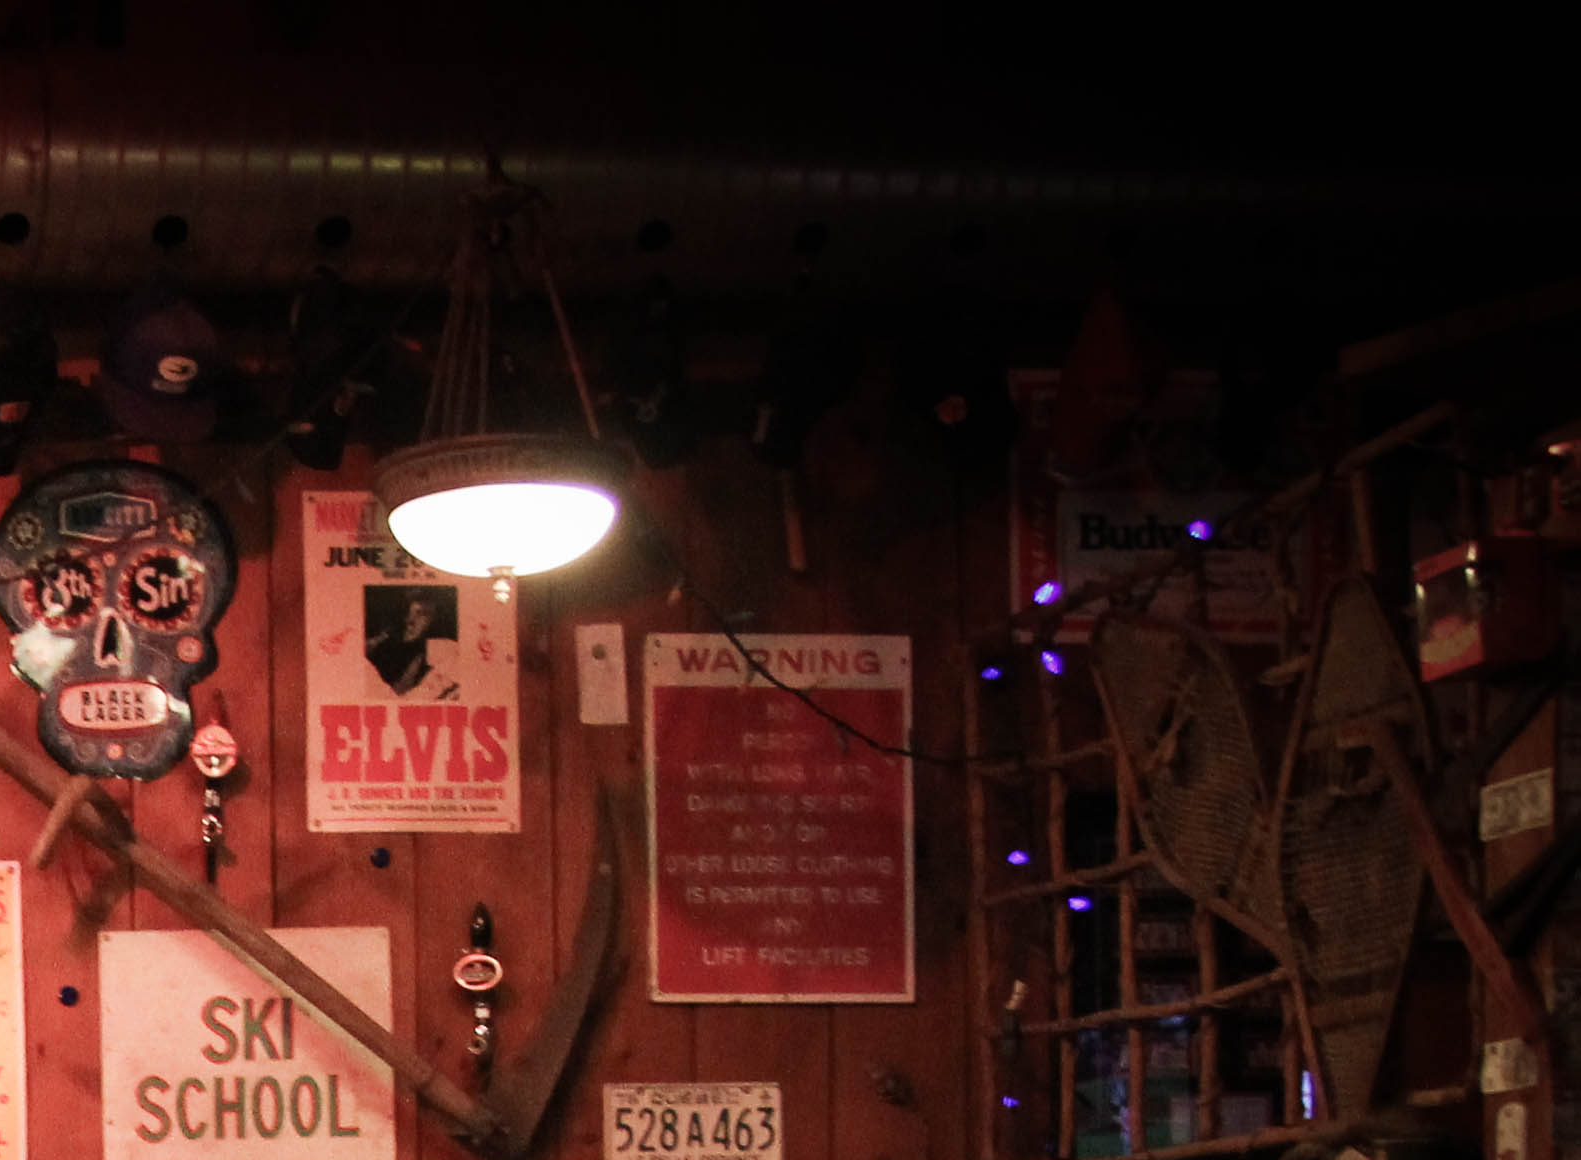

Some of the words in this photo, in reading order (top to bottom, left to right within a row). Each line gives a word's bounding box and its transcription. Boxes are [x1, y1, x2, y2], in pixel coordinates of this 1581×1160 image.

[324, 546, 386, 569] JUNE
[136, 567, 190, 612] Sin
[677, 647, 882, 676] WARNING
[80, 689, 145, 705] BLACK
[80, 706, 147, 722] LAGER
[320, 704, 510, 783] ELVIS
[201, 995, 295, 1066] SKI
[133, 1074, 361, 1144] SCHOOL
